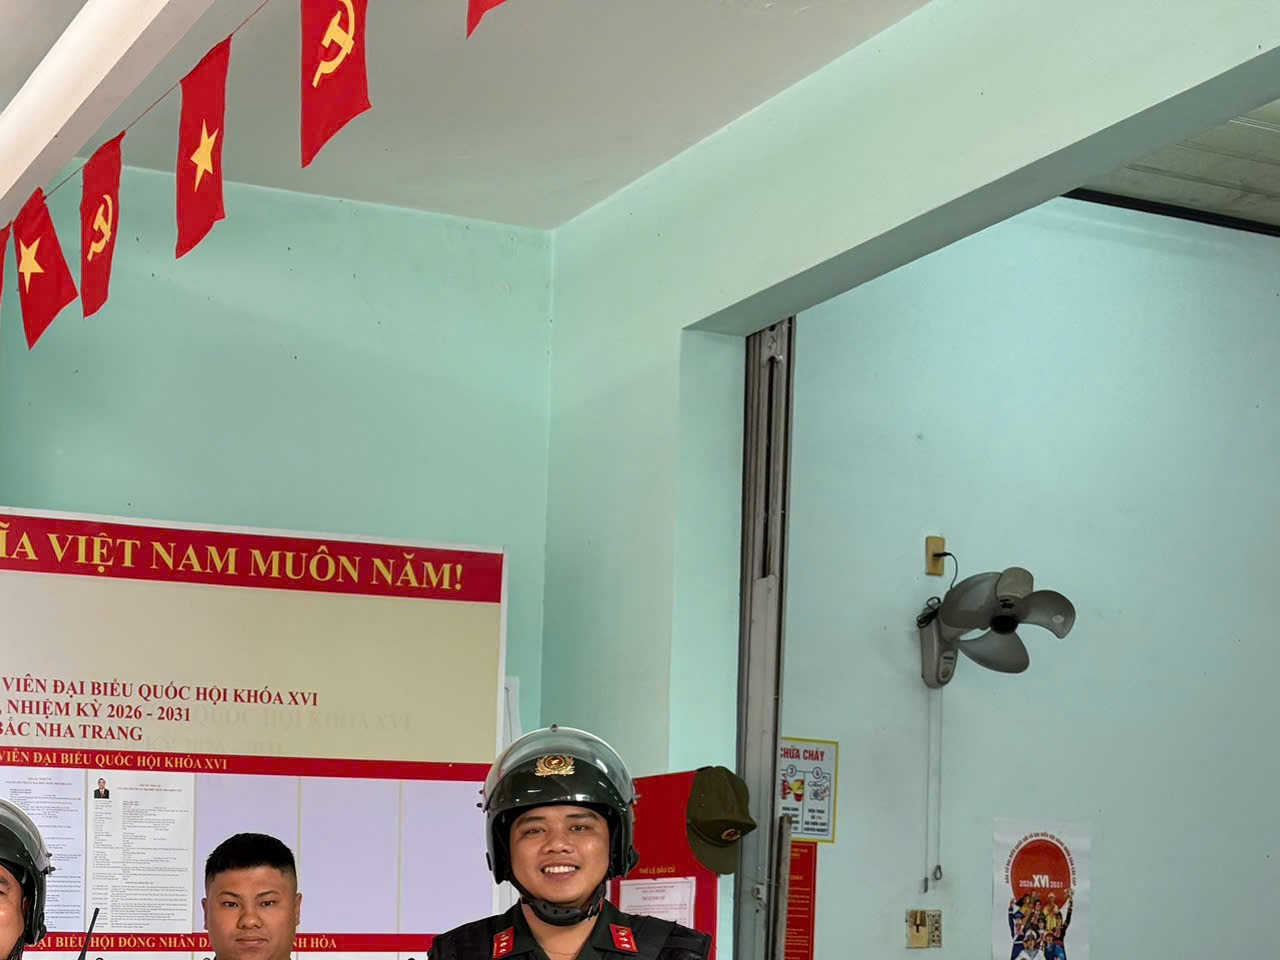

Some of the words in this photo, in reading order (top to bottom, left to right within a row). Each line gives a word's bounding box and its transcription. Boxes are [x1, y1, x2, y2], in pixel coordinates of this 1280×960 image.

[46, 531, 141, 573] VIỆT
[150, 541, 239, 575] NAM
[249, 545, 361, 583] MUÔN
[371, 553, 464, 591] NĂM!
[2, 673, 47, 694] VIÊN
[53, 679, 85, 699] ĐẠI
[90, 677, 133, 698] BIỂU
[138, 681, 190, 702] QUỐC
[195, 686, 228, 706] HỘI
[233, 685, 284, 706] KHÓA
[288, 691, 319, 706] XVI
[7, 698, 70, 719] NHIỆM
[76, 698, 101, 718] KỲ
[107, 703, 142, 719] 2026
[157, 706, 191, 722] 2031
[35, 722, 75, 738] NHA
[79, 724, 143, 742] TRANG
[33, 752, 57, 766] ĐẠI
[61, 751, 92, 765] BIỂU
[95, 752, 134, 768] QUỐC
[137, 755, 161, 770] HỘI
[164, 754, 202, 769] KHÓA
[204, 758, 227, 770] XVI
[802, 748, 825, 762] CHÁY
[1032, 874, 1049, 888] XVI
[28, 936, 52, 950] ẠI
[91, 935, 114, 950] HỘI
[118, 933, 156, 948] ĐỒNG
[159, 933, 196, 948] NHÂN
[310, 934, 337, 949] HÒA
